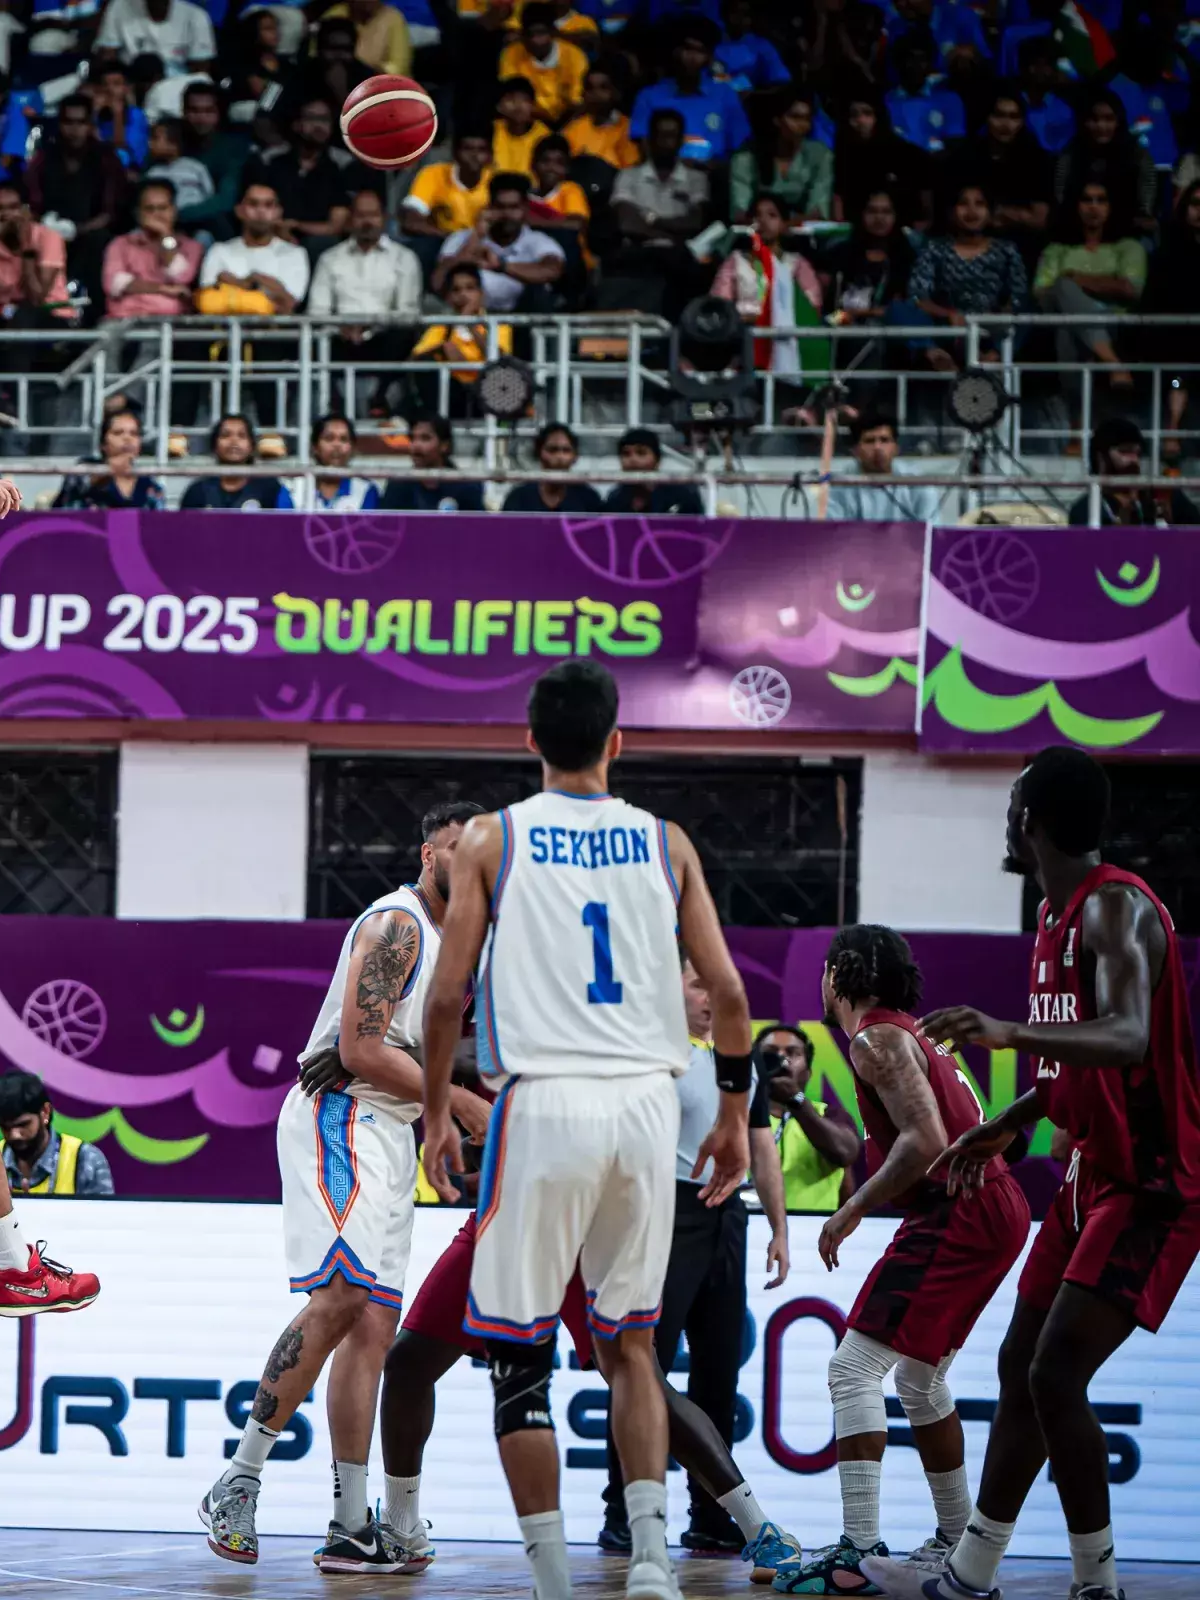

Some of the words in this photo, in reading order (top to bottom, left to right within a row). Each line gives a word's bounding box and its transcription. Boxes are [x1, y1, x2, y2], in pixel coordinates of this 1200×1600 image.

[103, 594, 259, 654] 2025
[272, 592, 662, 657] QUALIFIERS
[529, 826, 651, 870] SEKHON
[582, 902, 623, 1005] 1
